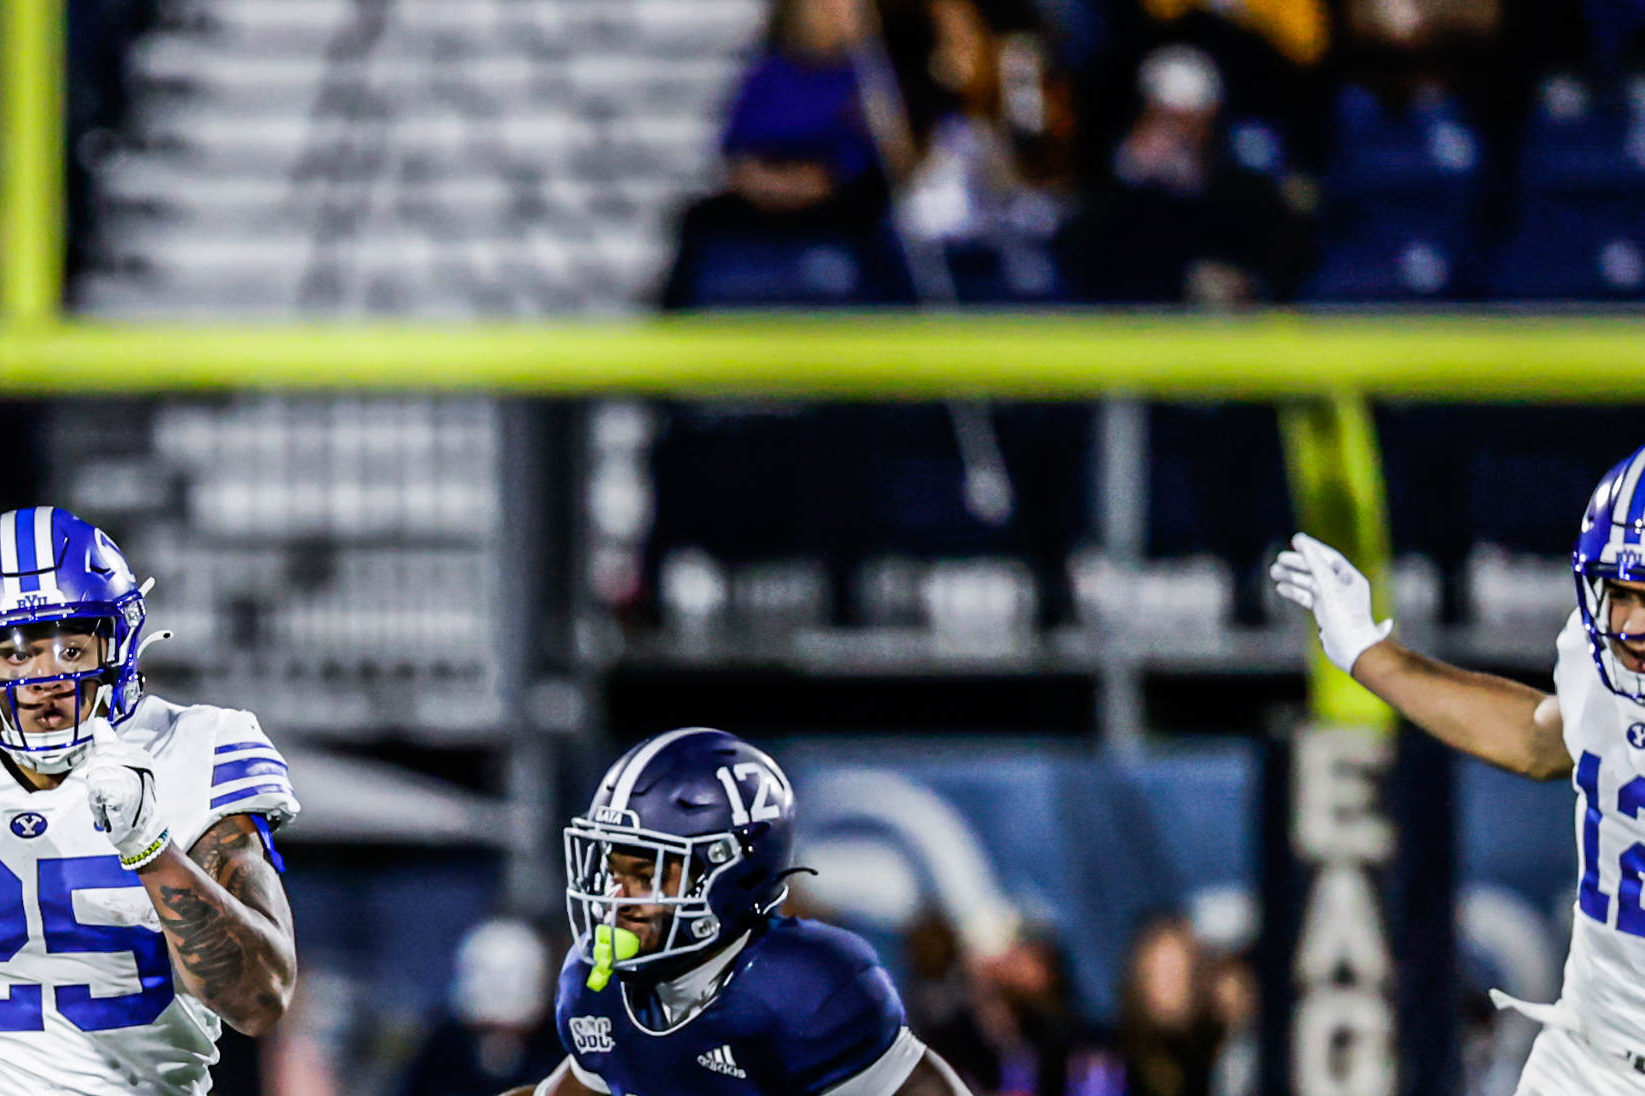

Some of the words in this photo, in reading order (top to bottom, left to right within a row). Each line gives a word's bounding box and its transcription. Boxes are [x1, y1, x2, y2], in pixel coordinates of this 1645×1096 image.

[717, 761, 780, 827] 12
[12, 813, 46, 838] Y
[568, 1015, 615, 1055] SBC
[696, 1054, 747, 1079] adidas
